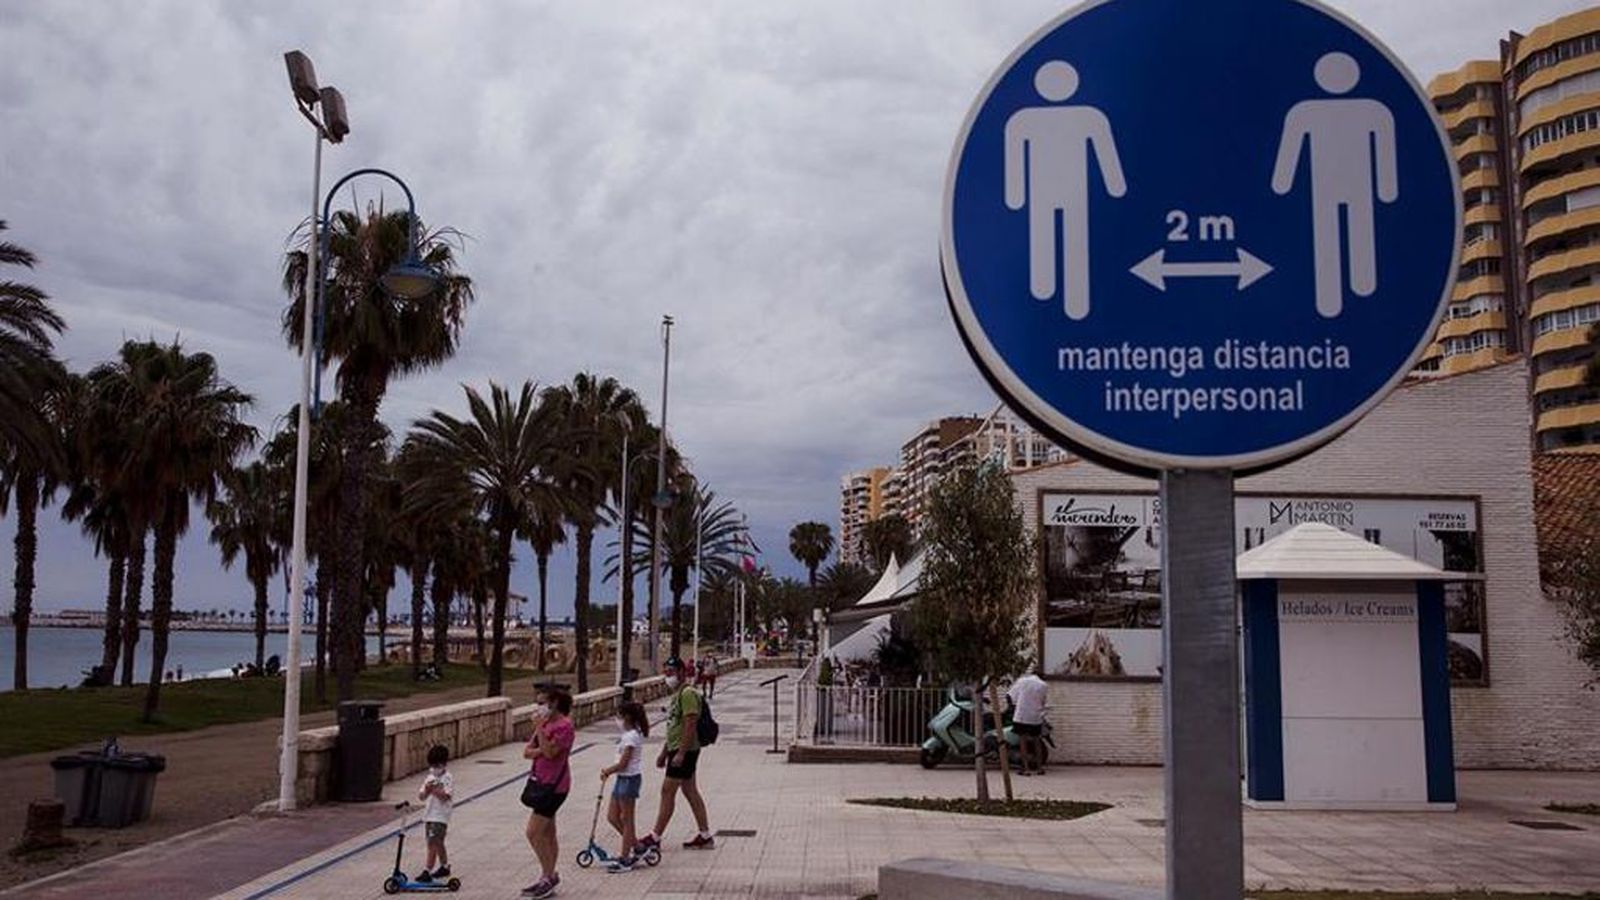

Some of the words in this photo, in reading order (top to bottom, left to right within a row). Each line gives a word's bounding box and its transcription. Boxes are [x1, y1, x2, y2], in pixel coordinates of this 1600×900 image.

[1166, 210, 1189, 241] 2
[1199, 214, 1235, 241] m
[1058, 342, 1204, 378] mantenga
[1214, 339, 1350, 370] distancia
[1105, 380, 1304, 418] interpersonal
[1295, 502, 1354, 512] ANTONIO
[1282, 600, 1333, 615] Helados
[1344, 600, 1363, 615] Ice
[1366, 600, 1415, 616] Creams
